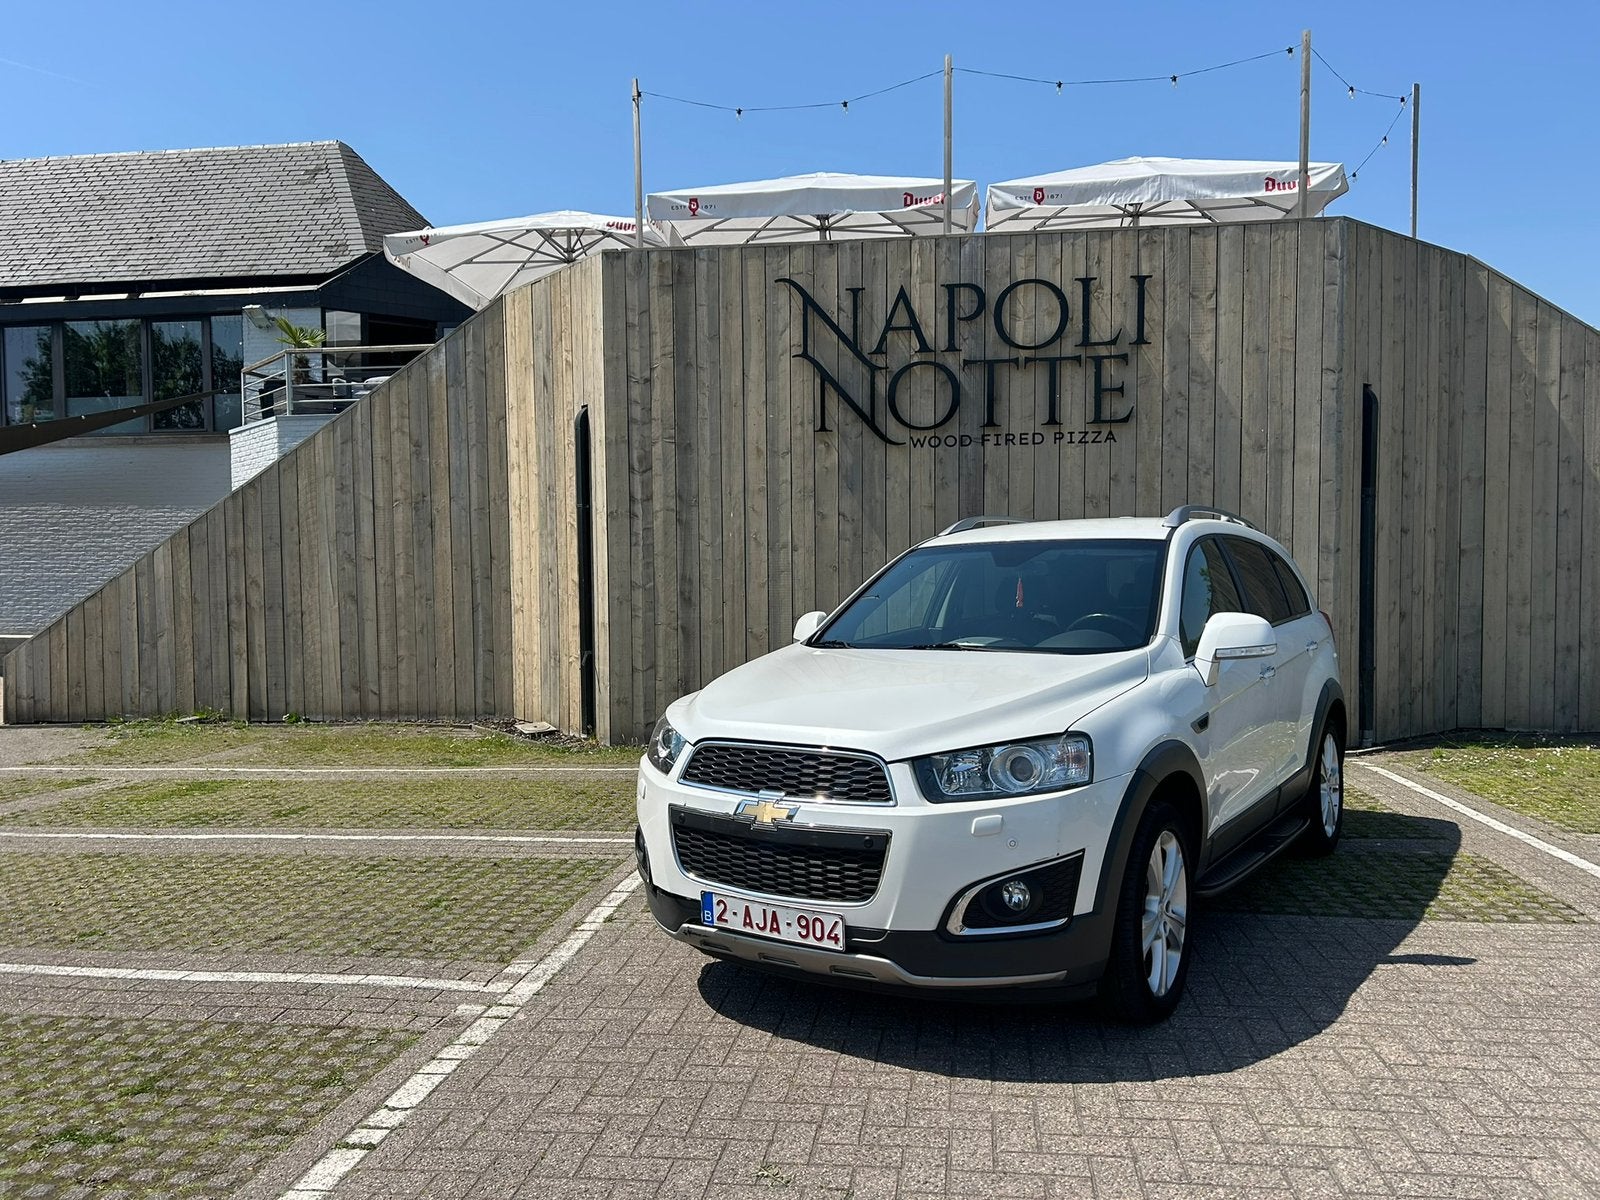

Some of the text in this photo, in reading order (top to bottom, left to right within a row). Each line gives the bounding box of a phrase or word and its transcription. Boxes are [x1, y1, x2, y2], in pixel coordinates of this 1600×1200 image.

[1264, 175, 1312, 192] Duvl
[774, 274, 1153, 370] NAPOLI
[792, 352, 1135, 446] NOTTE
[910, 430, 1118, 448] WOOD FIRED PIZZA
[704, 910, 712, 922] B
[716, 898, 840, 945] 2-AJA-904
